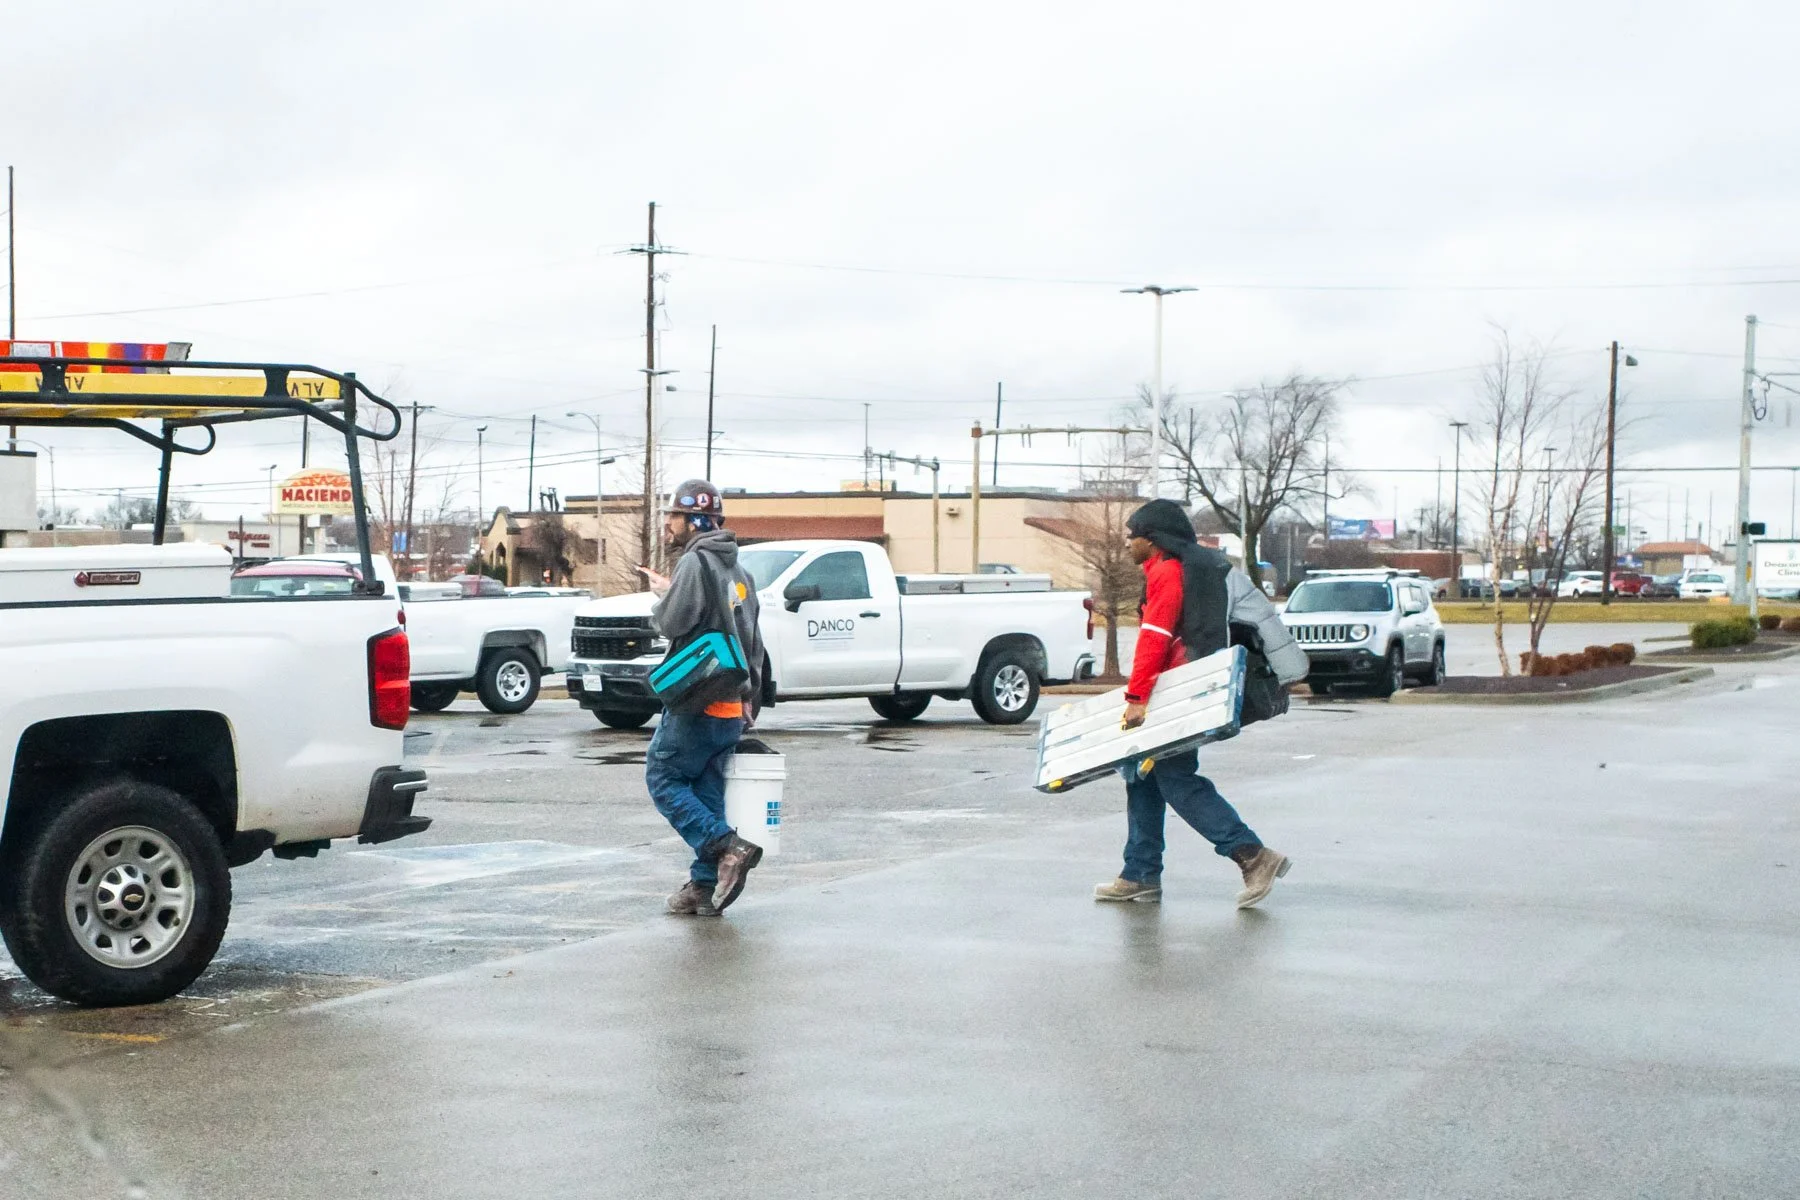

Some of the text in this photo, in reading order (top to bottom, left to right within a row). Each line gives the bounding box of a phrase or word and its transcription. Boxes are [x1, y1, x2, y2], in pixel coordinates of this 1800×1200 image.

[290, 382, 325, 397] ALV
[281, 488, 352, 502] HACIEND
[807, 618, 855, 638] DANCO
